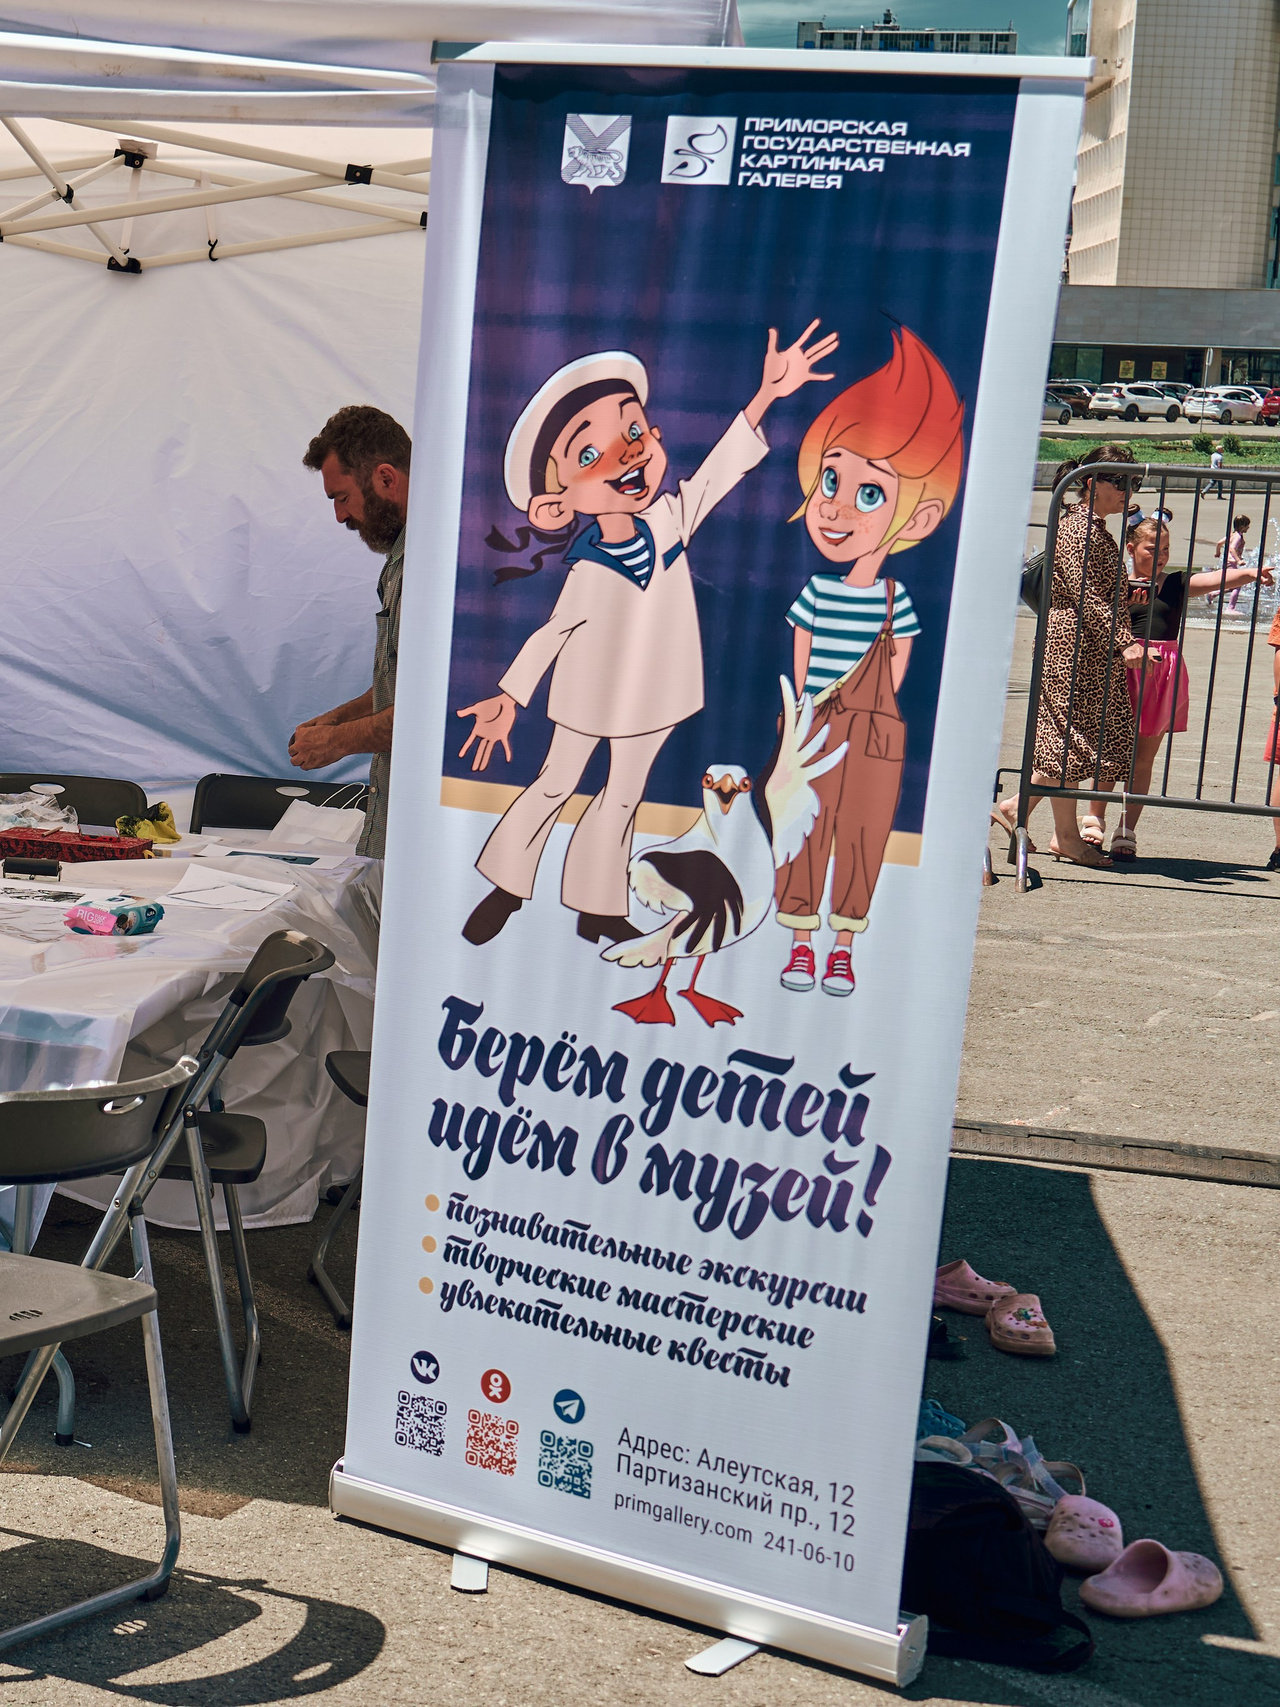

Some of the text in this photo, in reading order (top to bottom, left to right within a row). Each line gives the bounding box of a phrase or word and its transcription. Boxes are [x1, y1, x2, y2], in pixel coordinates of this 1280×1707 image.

[740, 154, 885, 172] КАРТИННАЯ
[741, 136, 971, 157] ГОСУДАРСТВЕННАЯ
[744, 117, 908, 136] ПРИМОРСКАЯ
[737, 172, 843, 189] ГАЛЕРЕЯ
[438, 995, 876, 1147] Берём детей
[428, 1098, 893, 1240] идём в музей!
[442, 1234, 815, 1349] творческие мастерские
[445, 1192, 868, 1314] познавательные экскурсии
[440, 1278, 791, 1388] увлекательные квесты
[617, 1427, 855, 1508] Адрес: Алеутская, 12
[617, 1453, 855, 1537] Партизанский пр., 12
[614, 1493, 854, 1572] primgallery.com 241-06-10
